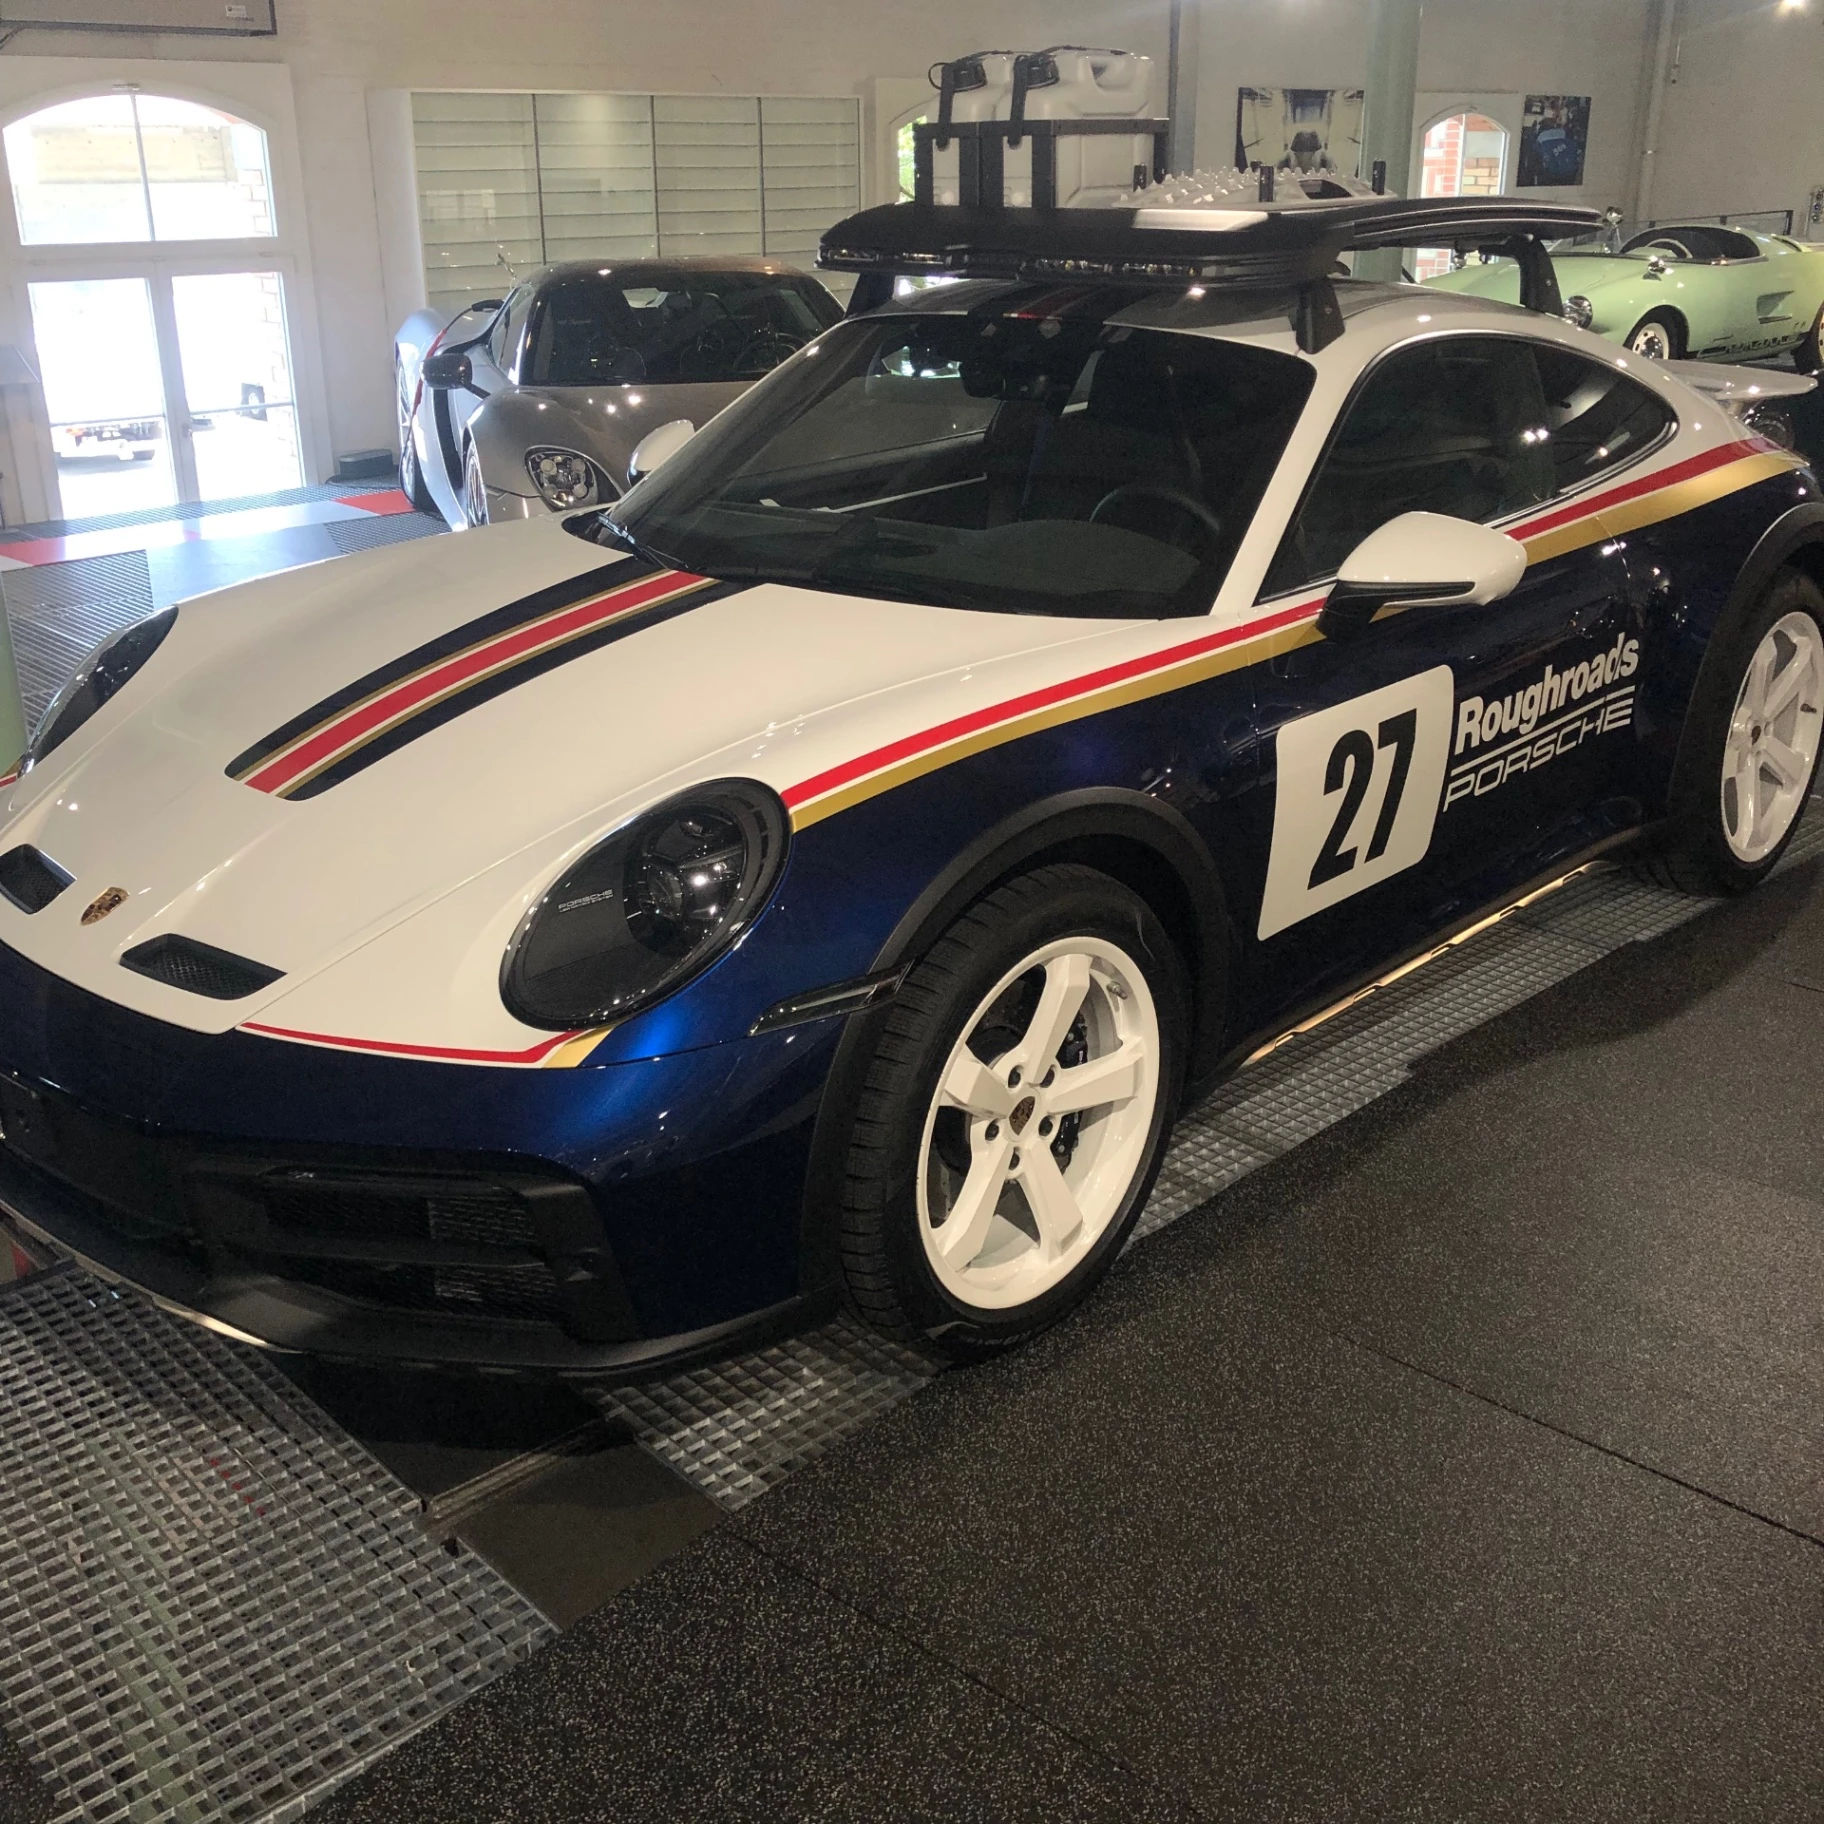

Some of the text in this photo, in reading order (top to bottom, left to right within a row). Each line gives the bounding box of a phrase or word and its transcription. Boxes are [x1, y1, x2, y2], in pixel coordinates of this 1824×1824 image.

[1454, 632, 1639, 756] Roughroads
[1307, 708, 1417, 890] 27
[1443, 698, 1634, 812] PORSCHE
[558, 889, 613, 909] PORSCHE
